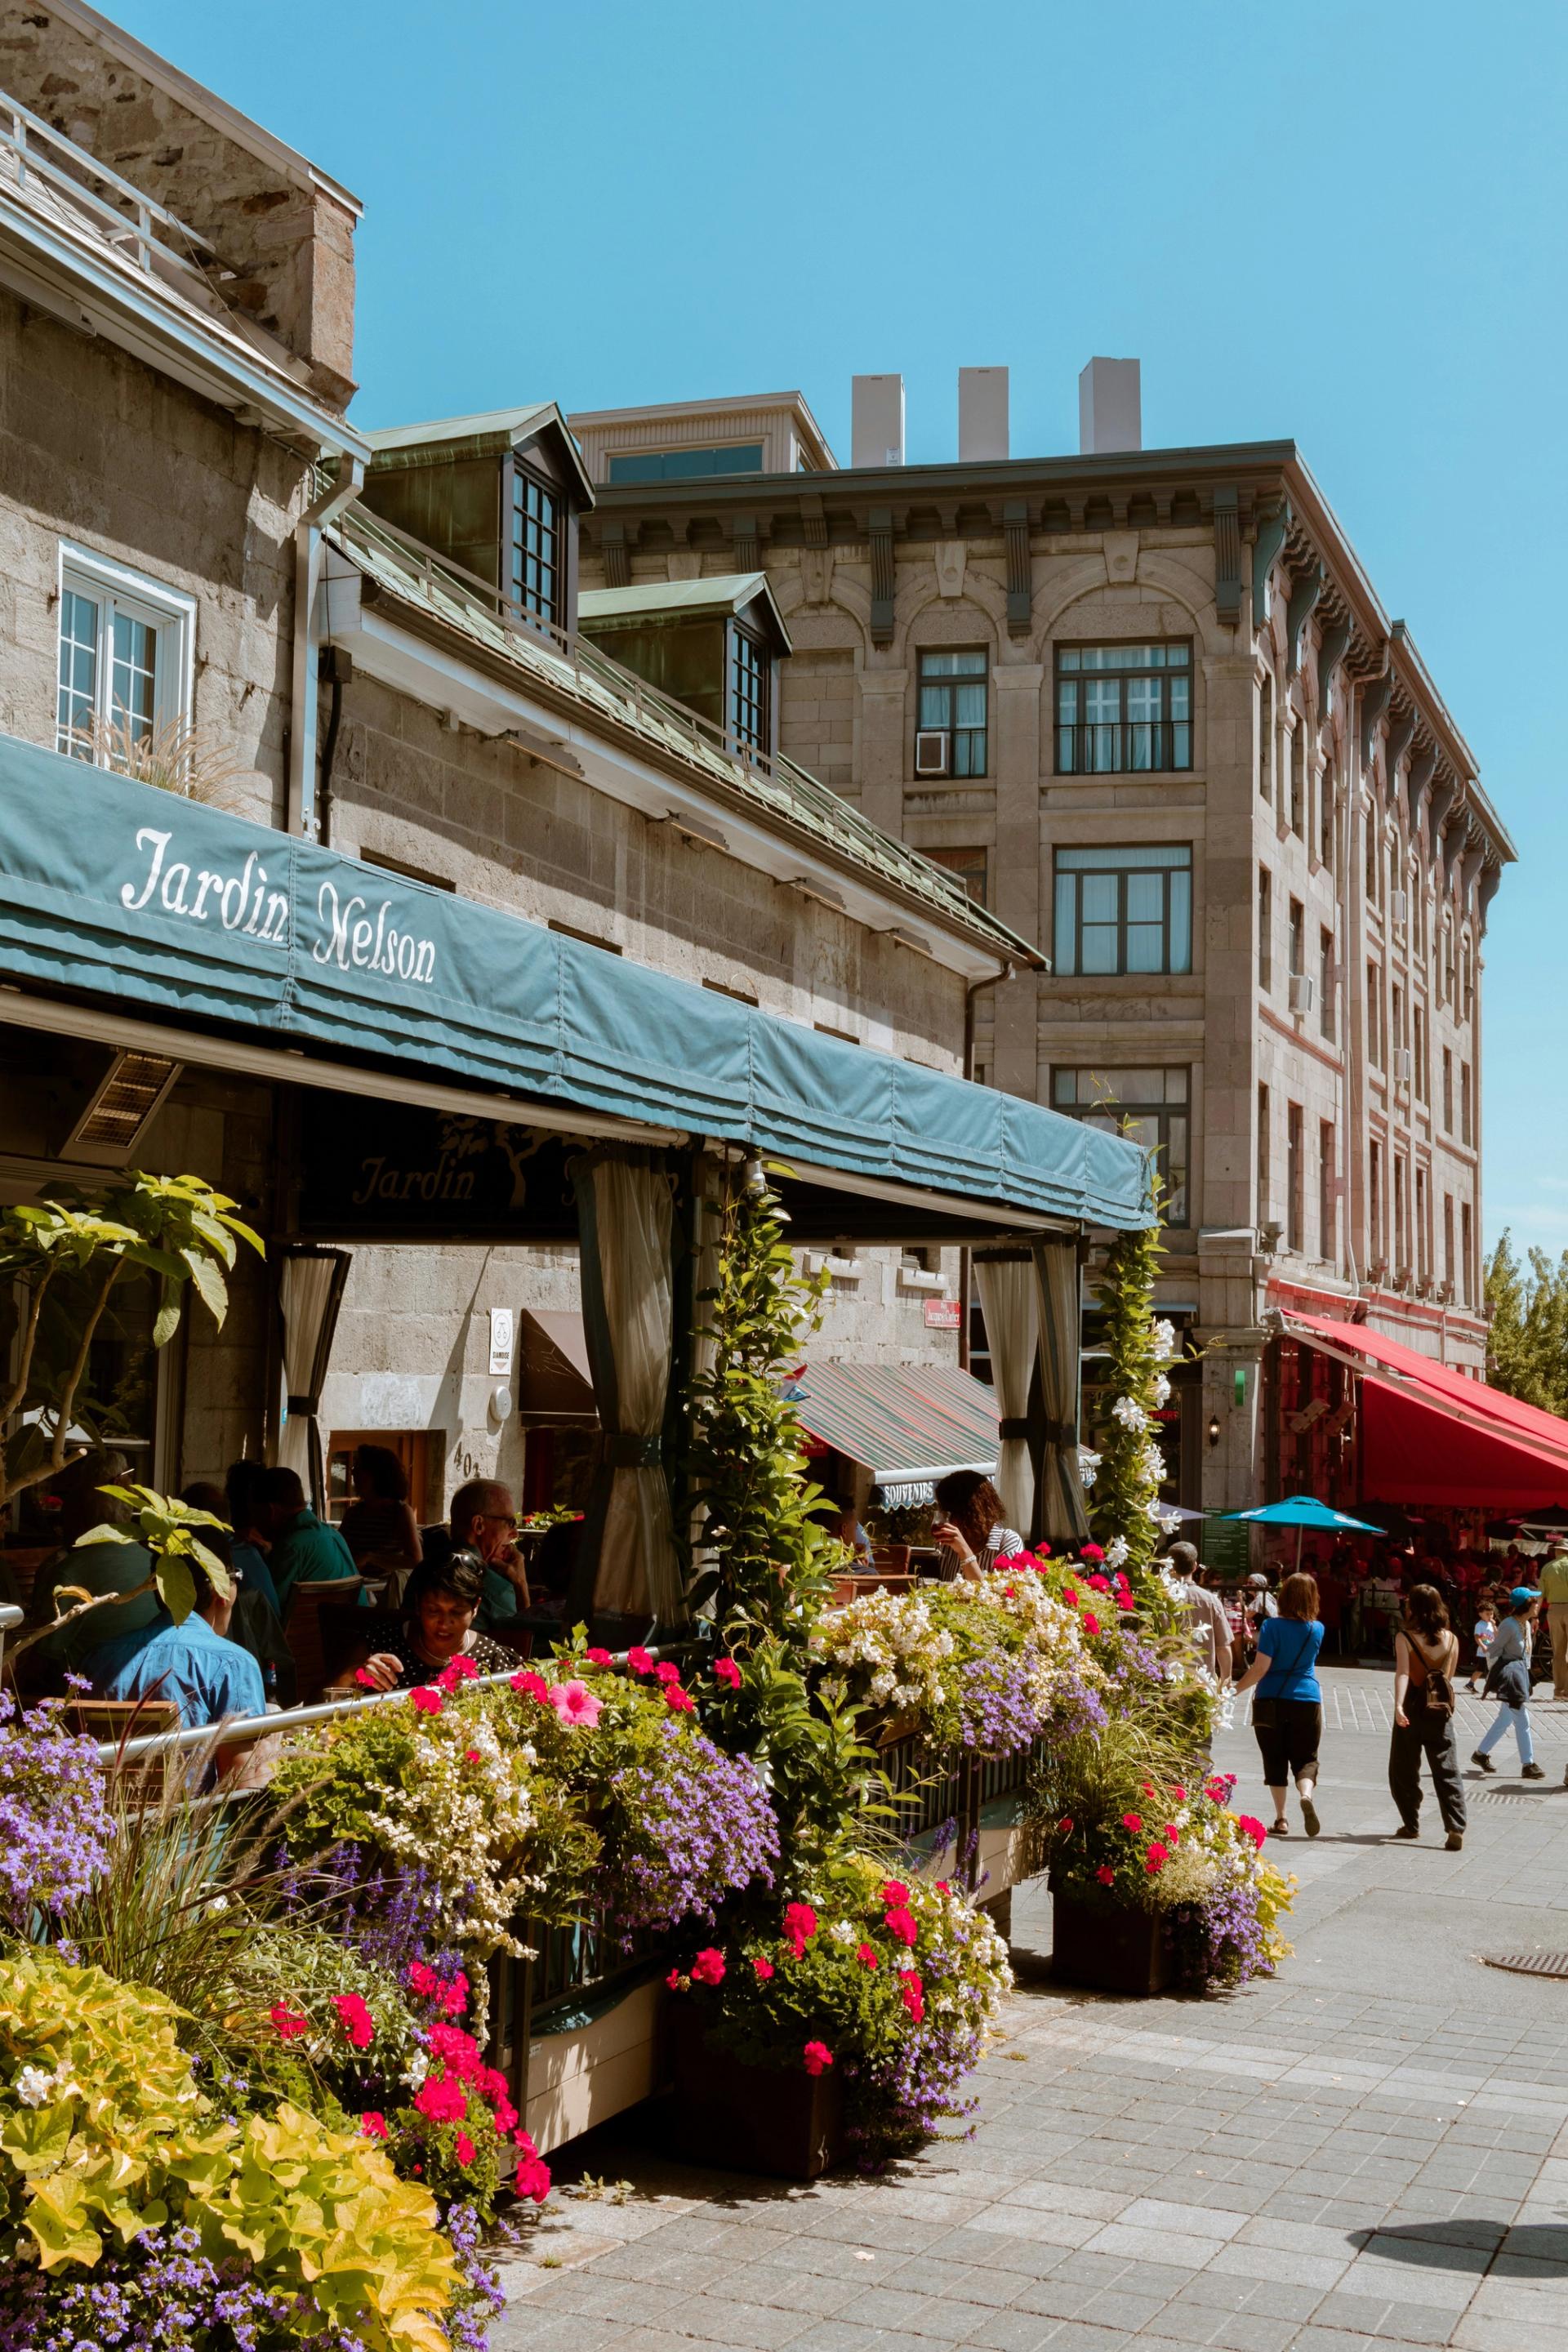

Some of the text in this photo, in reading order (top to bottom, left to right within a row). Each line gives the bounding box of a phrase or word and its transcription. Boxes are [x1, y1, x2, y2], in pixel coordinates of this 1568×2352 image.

[122, 827, 436, 983] Jardin Nelson
[352, 1150, 475, 1205] Jardin
